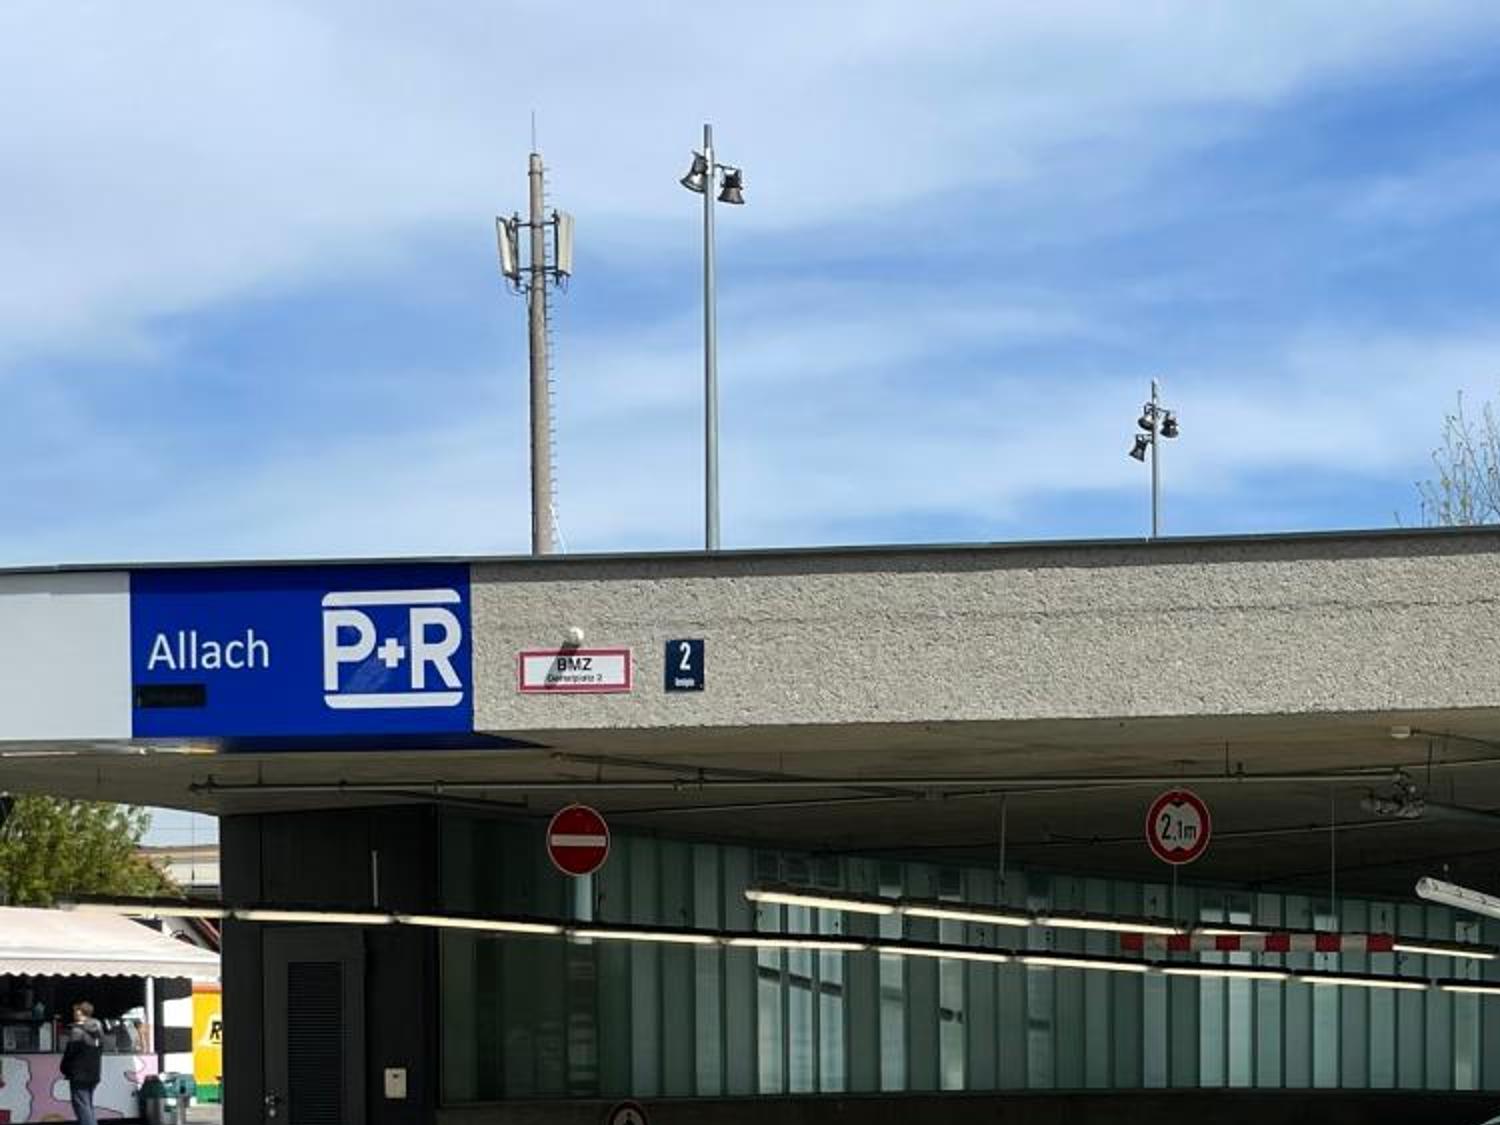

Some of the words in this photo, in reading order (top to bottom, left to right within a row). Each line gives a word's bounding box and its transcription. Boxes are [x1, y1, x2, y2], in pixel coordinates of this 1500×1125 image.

[148, 629, 270, 670] Allach
[323, 607, 463, 691] P+R
[557, 658, 592, 671] BMZ
[680, 642, 691, 670] 2
